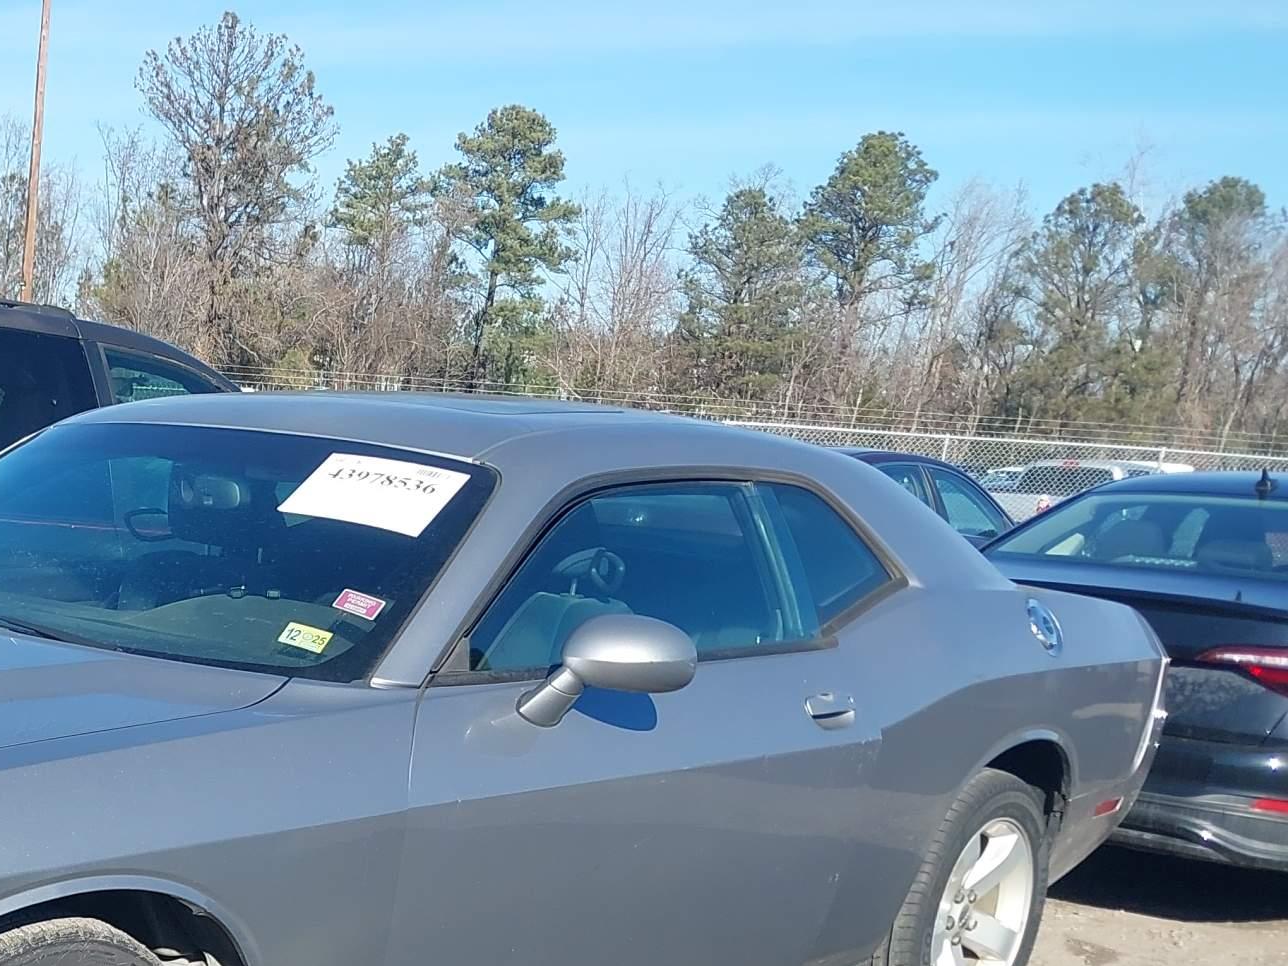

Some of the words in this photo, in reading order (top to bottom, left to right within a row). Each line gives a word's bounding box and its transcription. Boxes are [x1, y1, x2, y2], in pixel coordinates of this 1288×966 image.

[328, 467, 438, 495] 43978536
[285, 628, 302, 641] 12
[312, 635, 328, 646] 25
